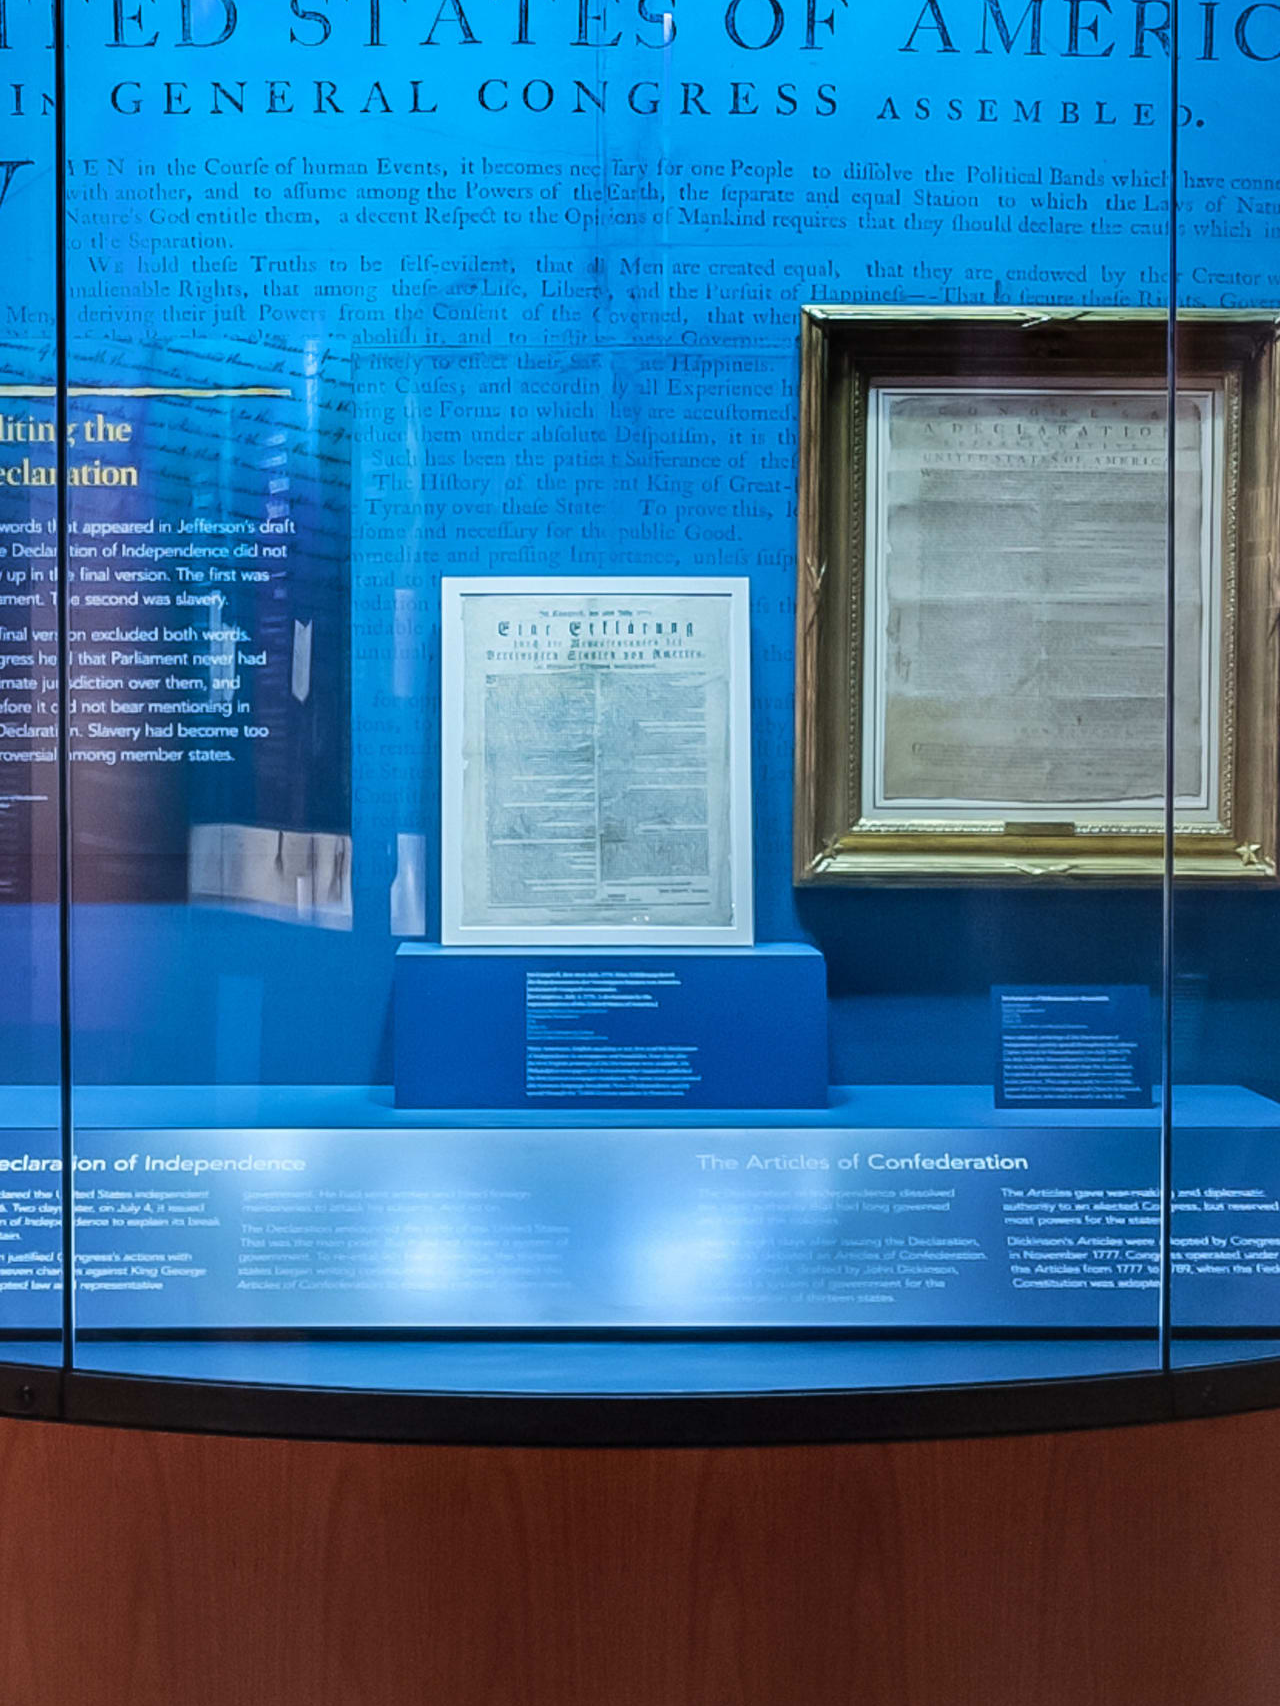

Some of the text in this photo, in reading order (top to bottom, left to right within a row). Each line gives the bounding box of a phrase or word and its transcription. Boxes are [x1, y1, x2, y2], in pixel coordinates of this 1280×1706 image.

[110, 79, 439, 116] GENERAL
[477, 79, 840, 117] CONGRESS
[167, 159, 196, 177] the
[302, 158, 367, 177] human
[376, 158, 448, 180] Events,
[481, 159, 562, 177] becomes
[731, 159, 793, 183] People
[925, 164, 955, 183] the
[968, 166, 1042, 186] Political
[1050, 167, 1105, 187] Bands
[356, 185, 419, 205] among
[466, 181, 533, 201] Powers
[852, 186, 901, 209] equal
[1031, 191, 1087, 211] which
[196, 207, 847, 231] entitle them, decent Mankind requires
[251, 255, 317, 273] Truths
[85, 414, 132, 442] the
[0, 519, 41, 533] words
[82, 519, 154, 536] appeared
[159, 519, 171, 533] in
[259, 518, 296, 534] draft
[12, 543, 97, 558] Declartion
[102, 542, 118, 558] of
[122, 543, 230, 561] Independence
[233, 543, 258, 557] did
[262, 544, 287, 557] not
[7, 570, 26, 586] up
[31, 567, 44, 582] in
[80, 567, 110, 582] final
[114, 567, 171, 582] version.
[176, 567, 205, 582] The
[209, 566, 236, 582] first
[241, 570, 270, 581] was
[85, 591, 138, 606] second
[142, 595, 171, 606] was
[176, 591, 229, 610] slavery.
[91, 626, 158, 642] excluded
[163, 626, 198, 642] both
[202, 626, 251, 642] words.
[78, 651, 106, 666] that
[111, 651, 188, 666] Parliament
[193, 654, 234, 666] never
[238, 651, 267, 666] had
[42, 675, 123, 693] jurdiction
[128, 678, 161, 690] over
[166, 675, 207, 691] them,
[212, 675, 240, 690] and
[37, 699, 46, 713] it
[82, 702, 106, 713] not
[111, 699, 145, 713] bear
[148, 700, 232, 718] mentioning
[237, 700, 250, 713] in
[88, 723, 141, 741] Slavery
[145, 723, 173, 738] had
[178, 723, 239, 738] become
[244, 725, 269, 738] too
[121, 747, 184, 761] member
[188, 749, 235, 761] states.
[114, 1153, 139, 1172] of
[145, 1153, 306, 1175] Independence
[696, 1153, 1029, 1171] The Articles of Confederation
